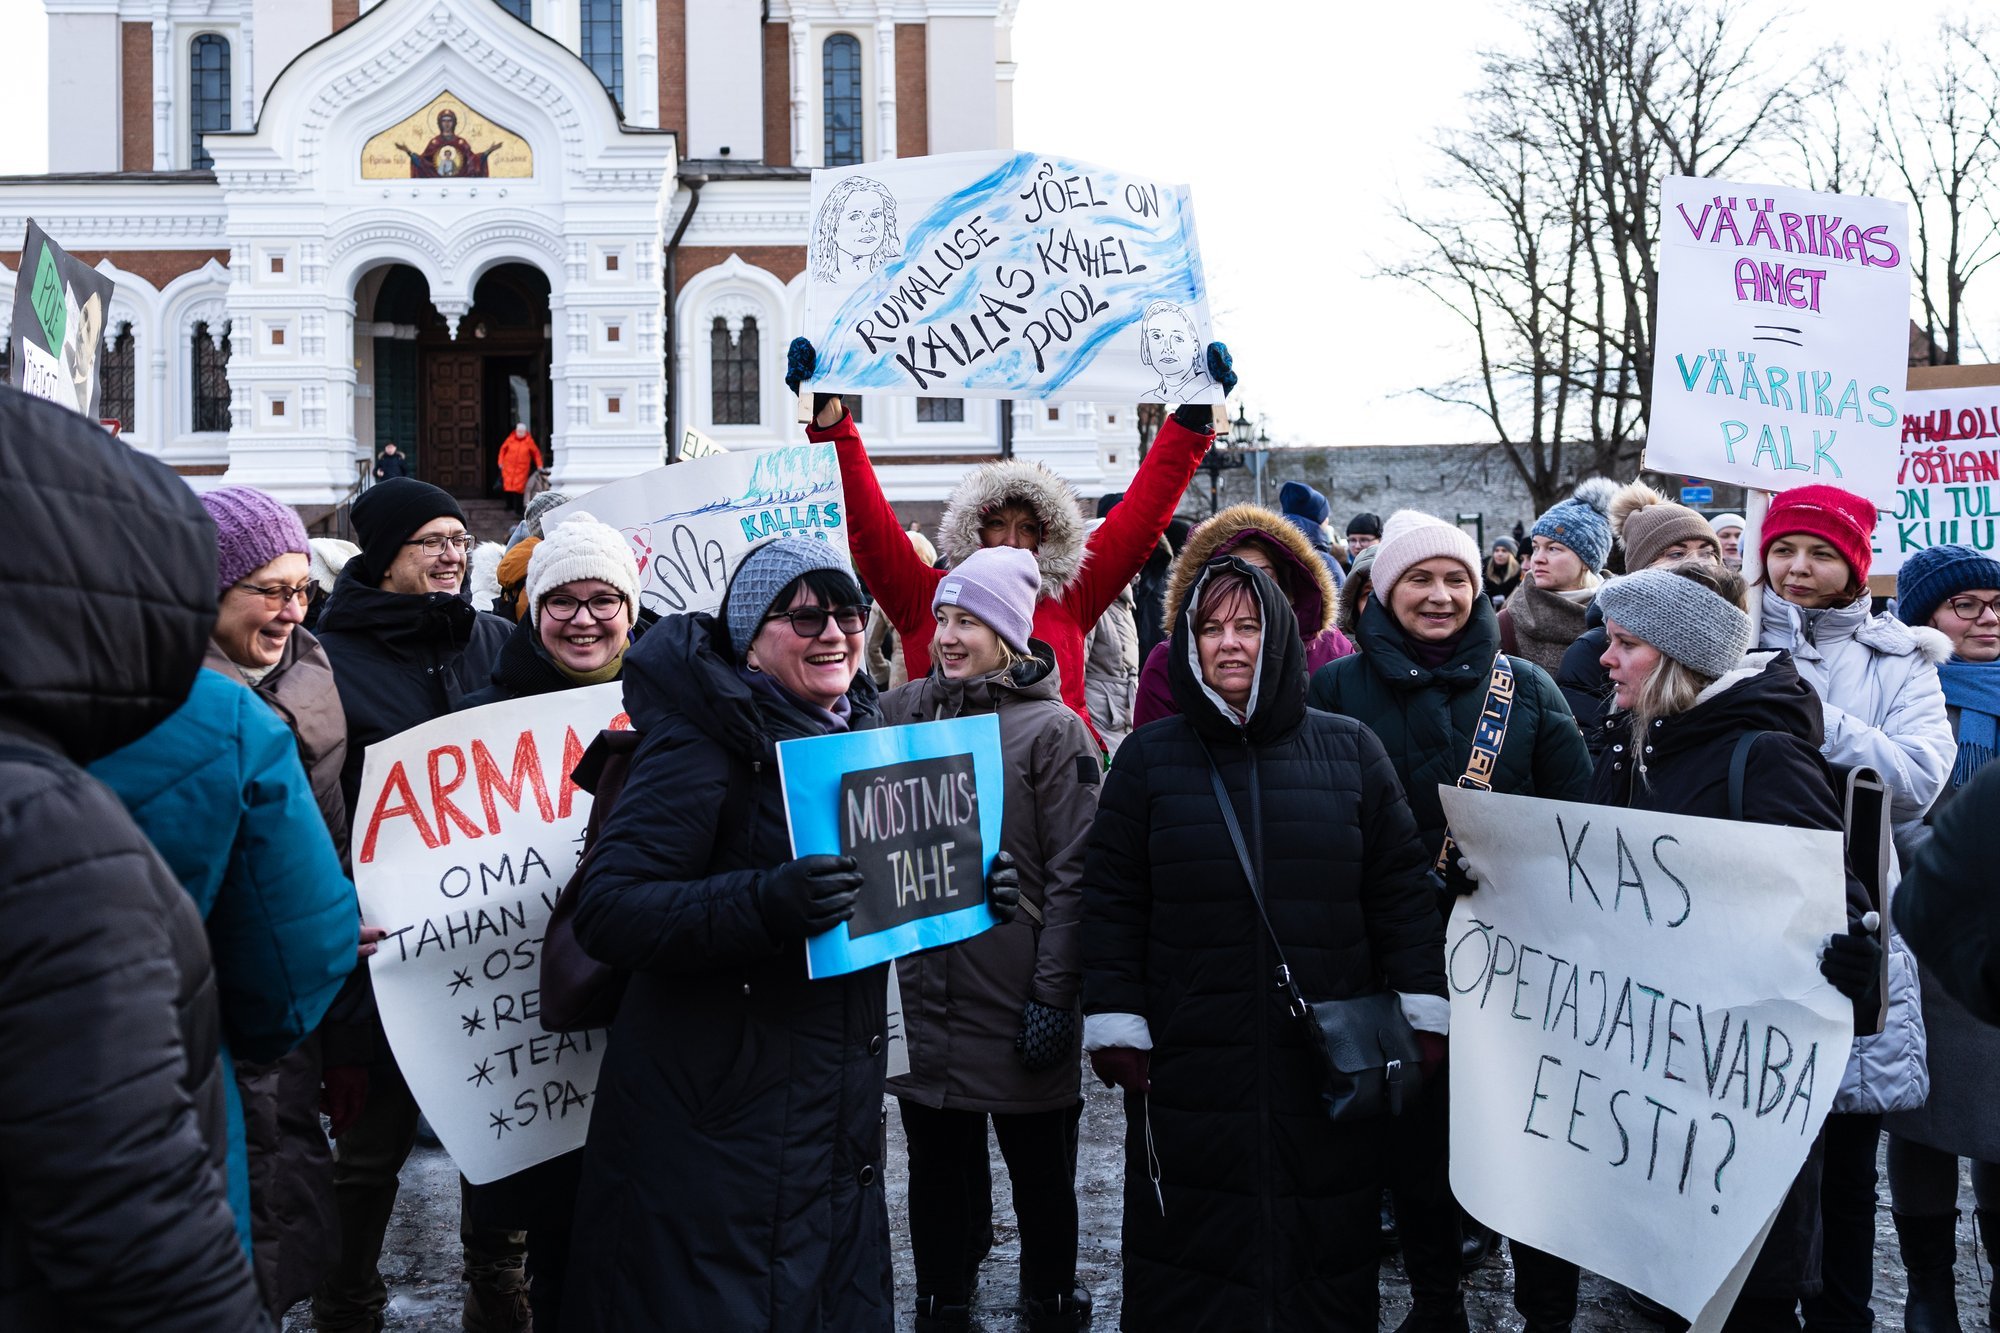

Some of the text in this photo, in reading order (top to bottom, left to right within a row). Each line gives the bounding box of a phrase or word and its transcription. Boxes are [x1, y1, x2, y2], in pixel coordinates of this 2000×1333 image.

[856, 162, 1160, 354] RUMALUSE JÕEL ON
[1676, 196, 1900, 268] VÄÄRIKAS
[896, 228, 1147, 390] KALLAS KAHEL
[1735, 257, 1827, 313] AMET
[1022, 284, 1110, 374] POOL
[1675, 348, 1898, 428] VÄÄRIKAS
[1902, 406, 2000, 443] AHULOL
[1720, 420, 1844, 478] PALK
[740, 502, 842, 542] KALLAS
[359, 713, 631, 864] ARMA
[847, 772, 977, 848] MÕISTMIS-
[440, 846, 551, 899] OMA
[887, 841, 959, 908] TAHE
[1556, 813, 1692, 928] KAS
[384, 900, 527, 962] TAHAN
[482, 938, 545, 981] OS
[1449, 919, 1818, 1136] ÕPETAJATEVABA
[1523, 1054, 1737, 1215] EESTI?
